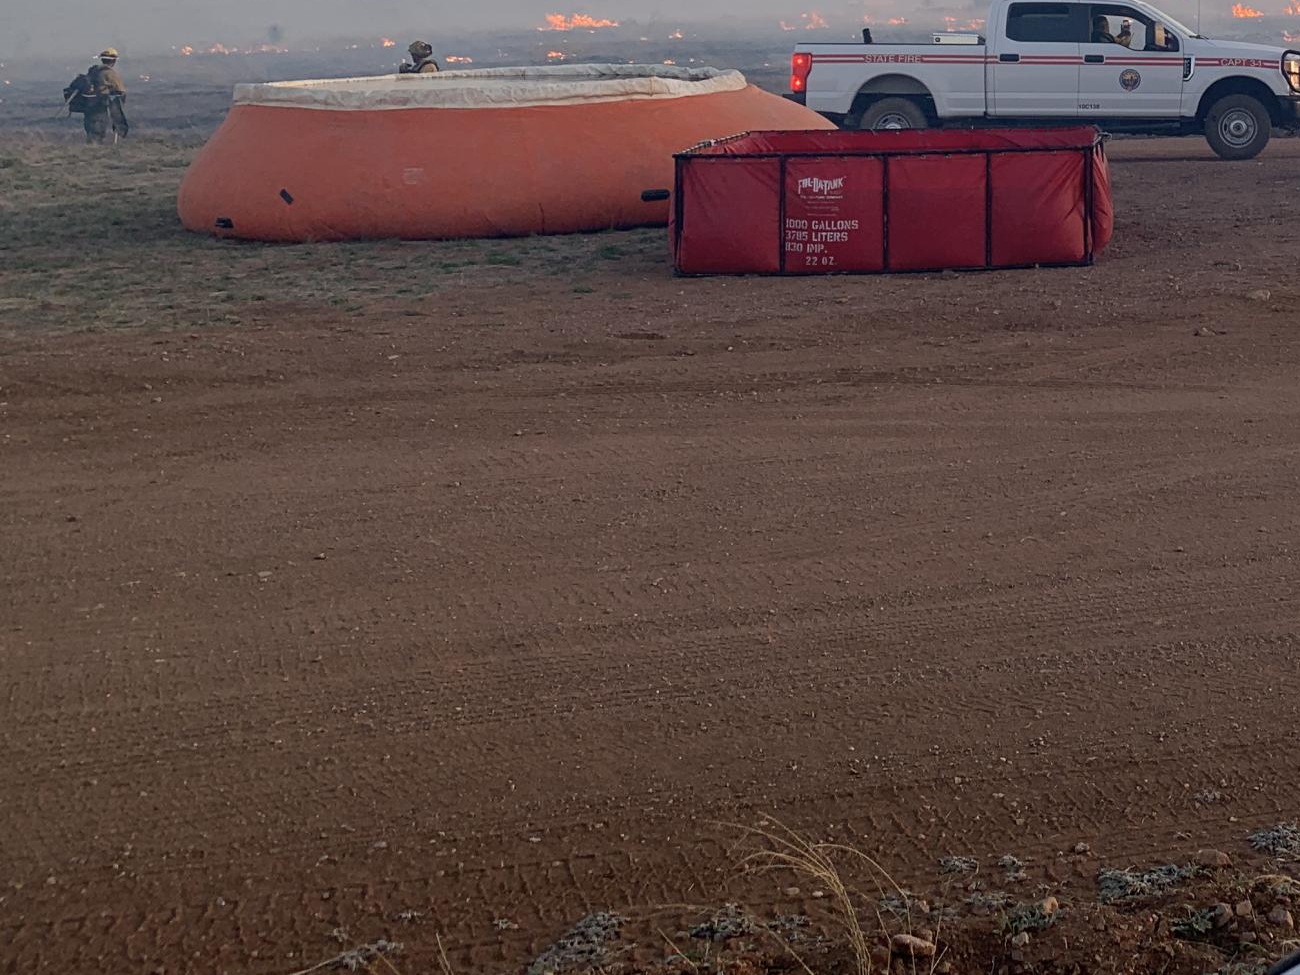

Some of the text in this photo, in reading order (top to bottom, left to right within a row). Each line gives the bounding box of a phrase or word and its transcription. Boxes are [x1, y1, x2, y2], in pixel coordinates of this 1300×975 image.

[864, 54, 921, 63] STATE FIRE
[1220, 58, 1246, 66] CAPT
[786, 219, 859, 231] 1000 GALLONS
[785, 230, 849, 242] 3785 LITERS
[806, 243, 828, 254] IMP.
[805, 256, 818, 266] 22
